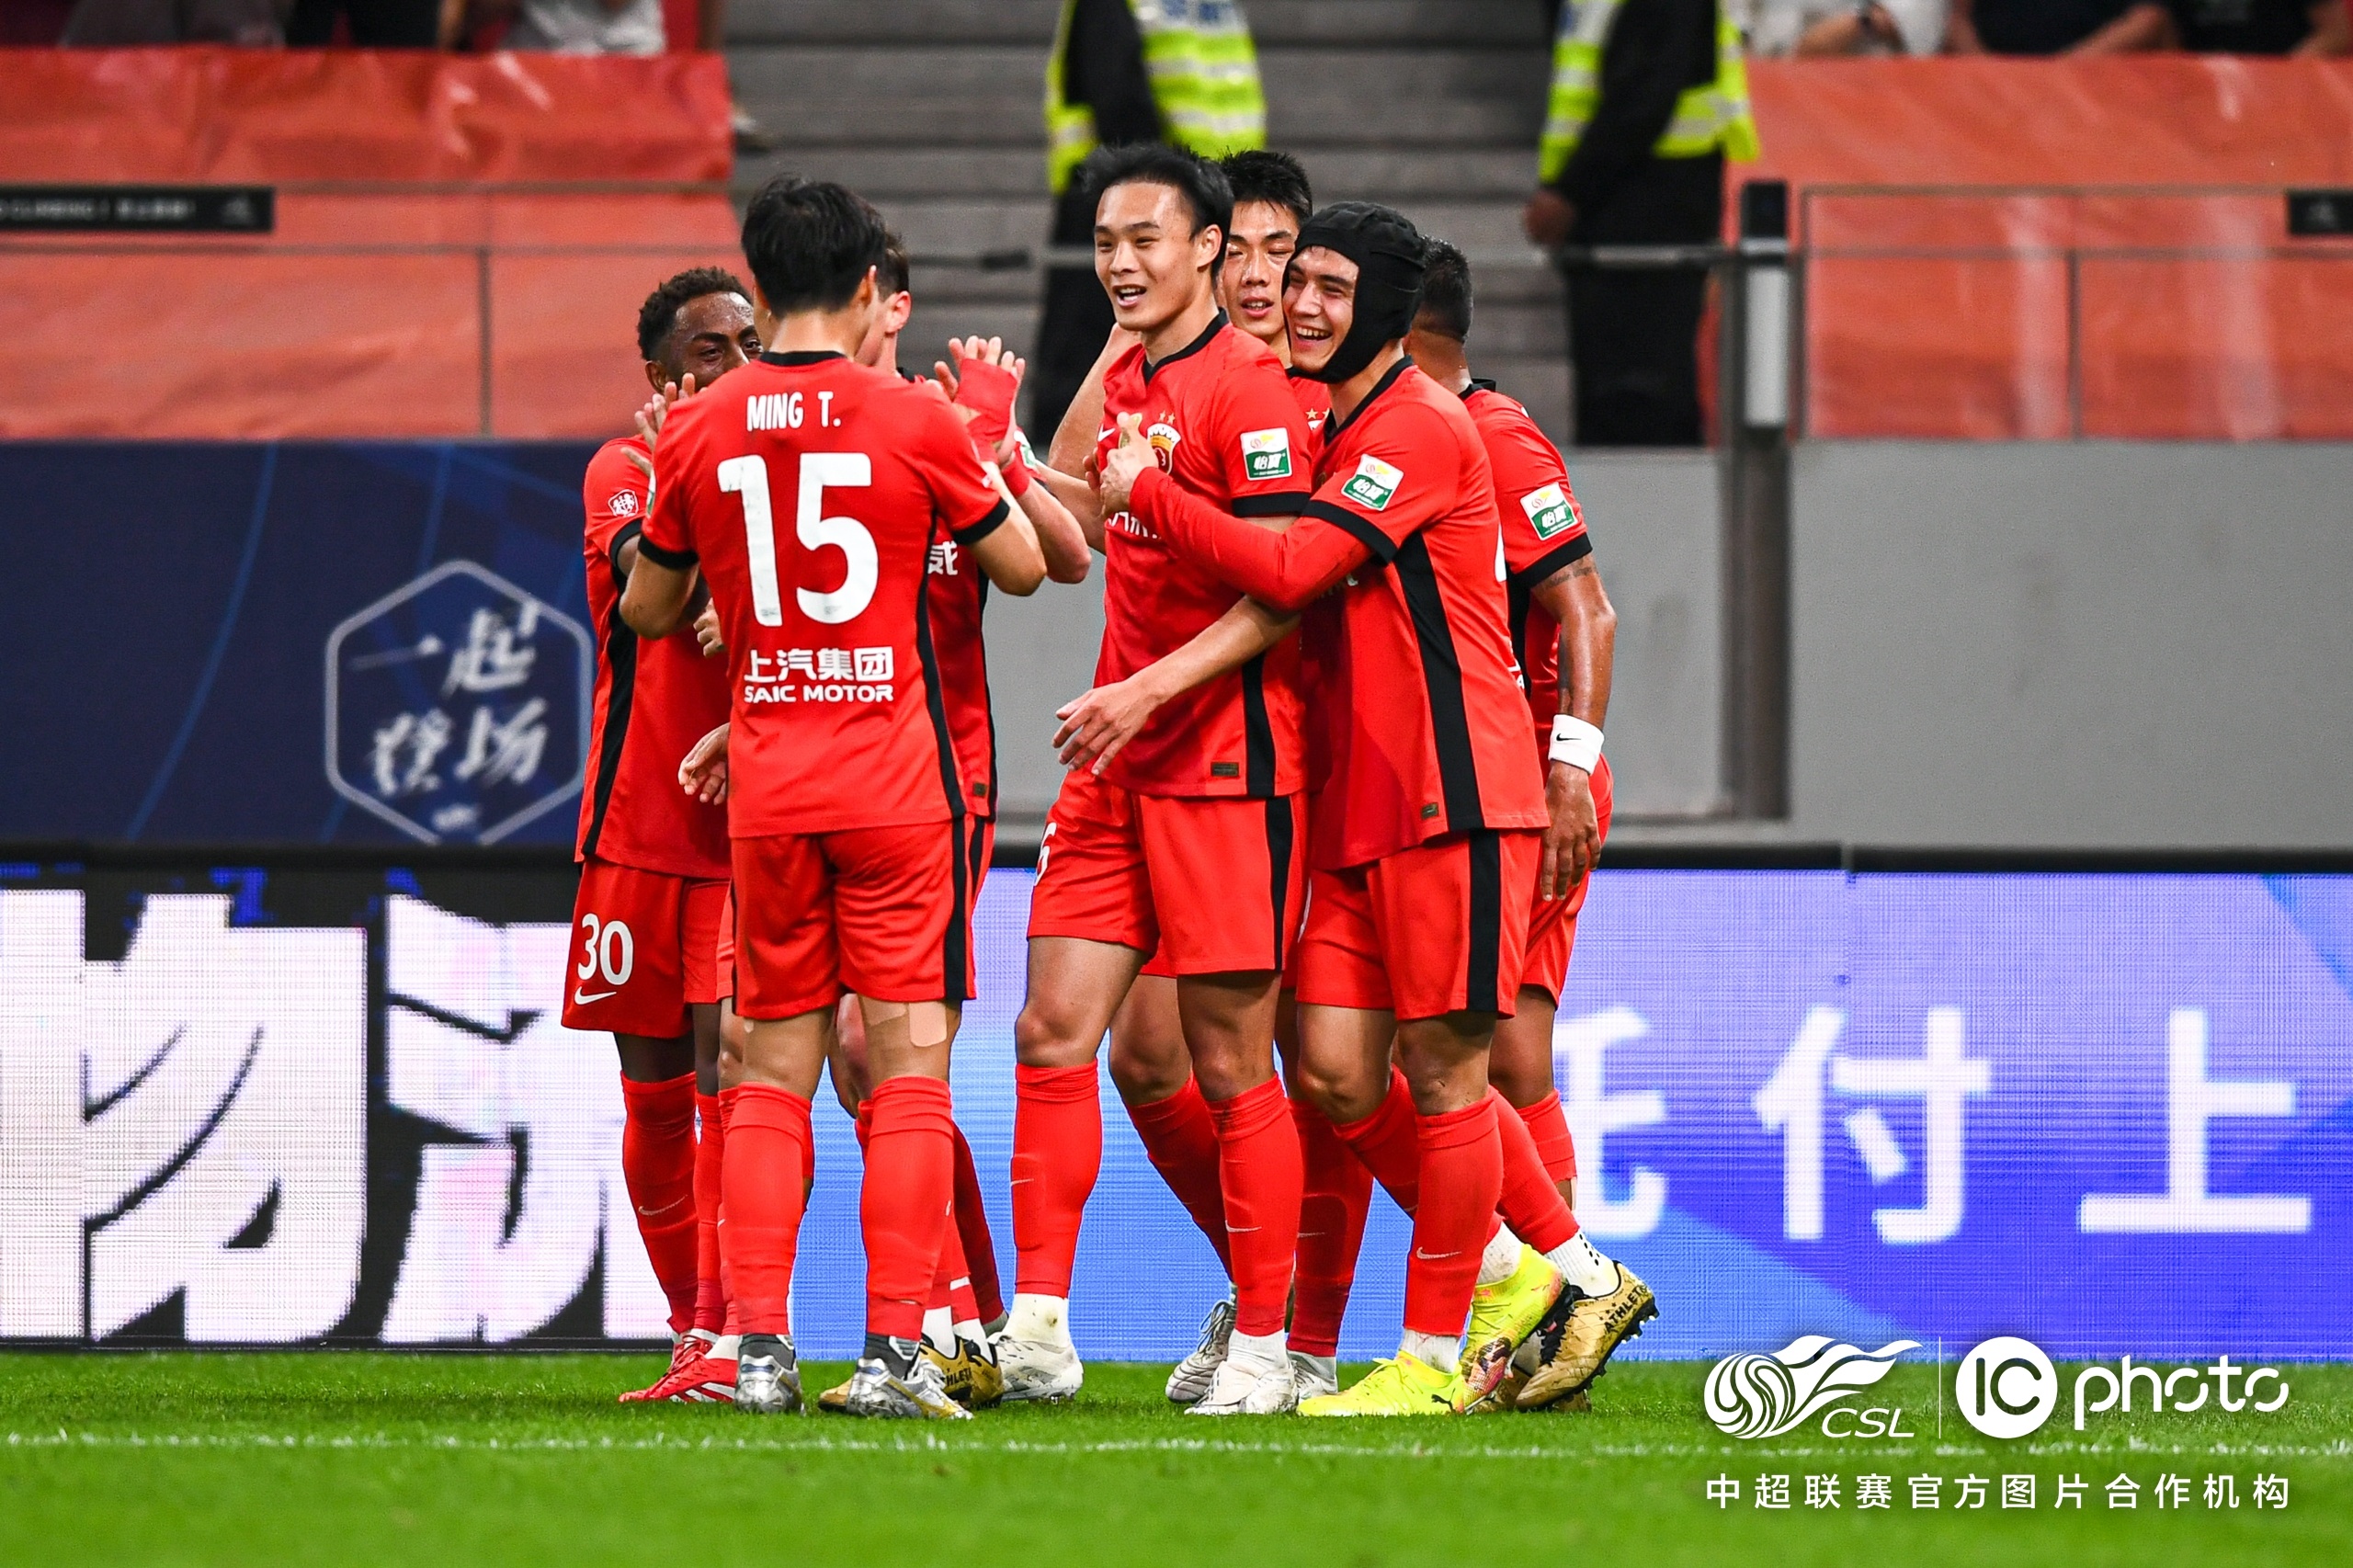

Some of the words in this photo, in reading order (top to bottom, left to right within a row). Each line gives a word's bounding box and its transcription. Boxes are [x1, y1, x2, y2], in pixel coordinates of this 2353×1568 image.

[747, 392, 803, 431] MING
[817, 391, 841, 427] T.
[717, 452, 880, 626] 15
[744, 646, 894, 684] 上汽集团
[744, 685, 797, 703] SAIC
[803, 685, 894, 703] MOTOR
[578, 913, 633, 985] 30
